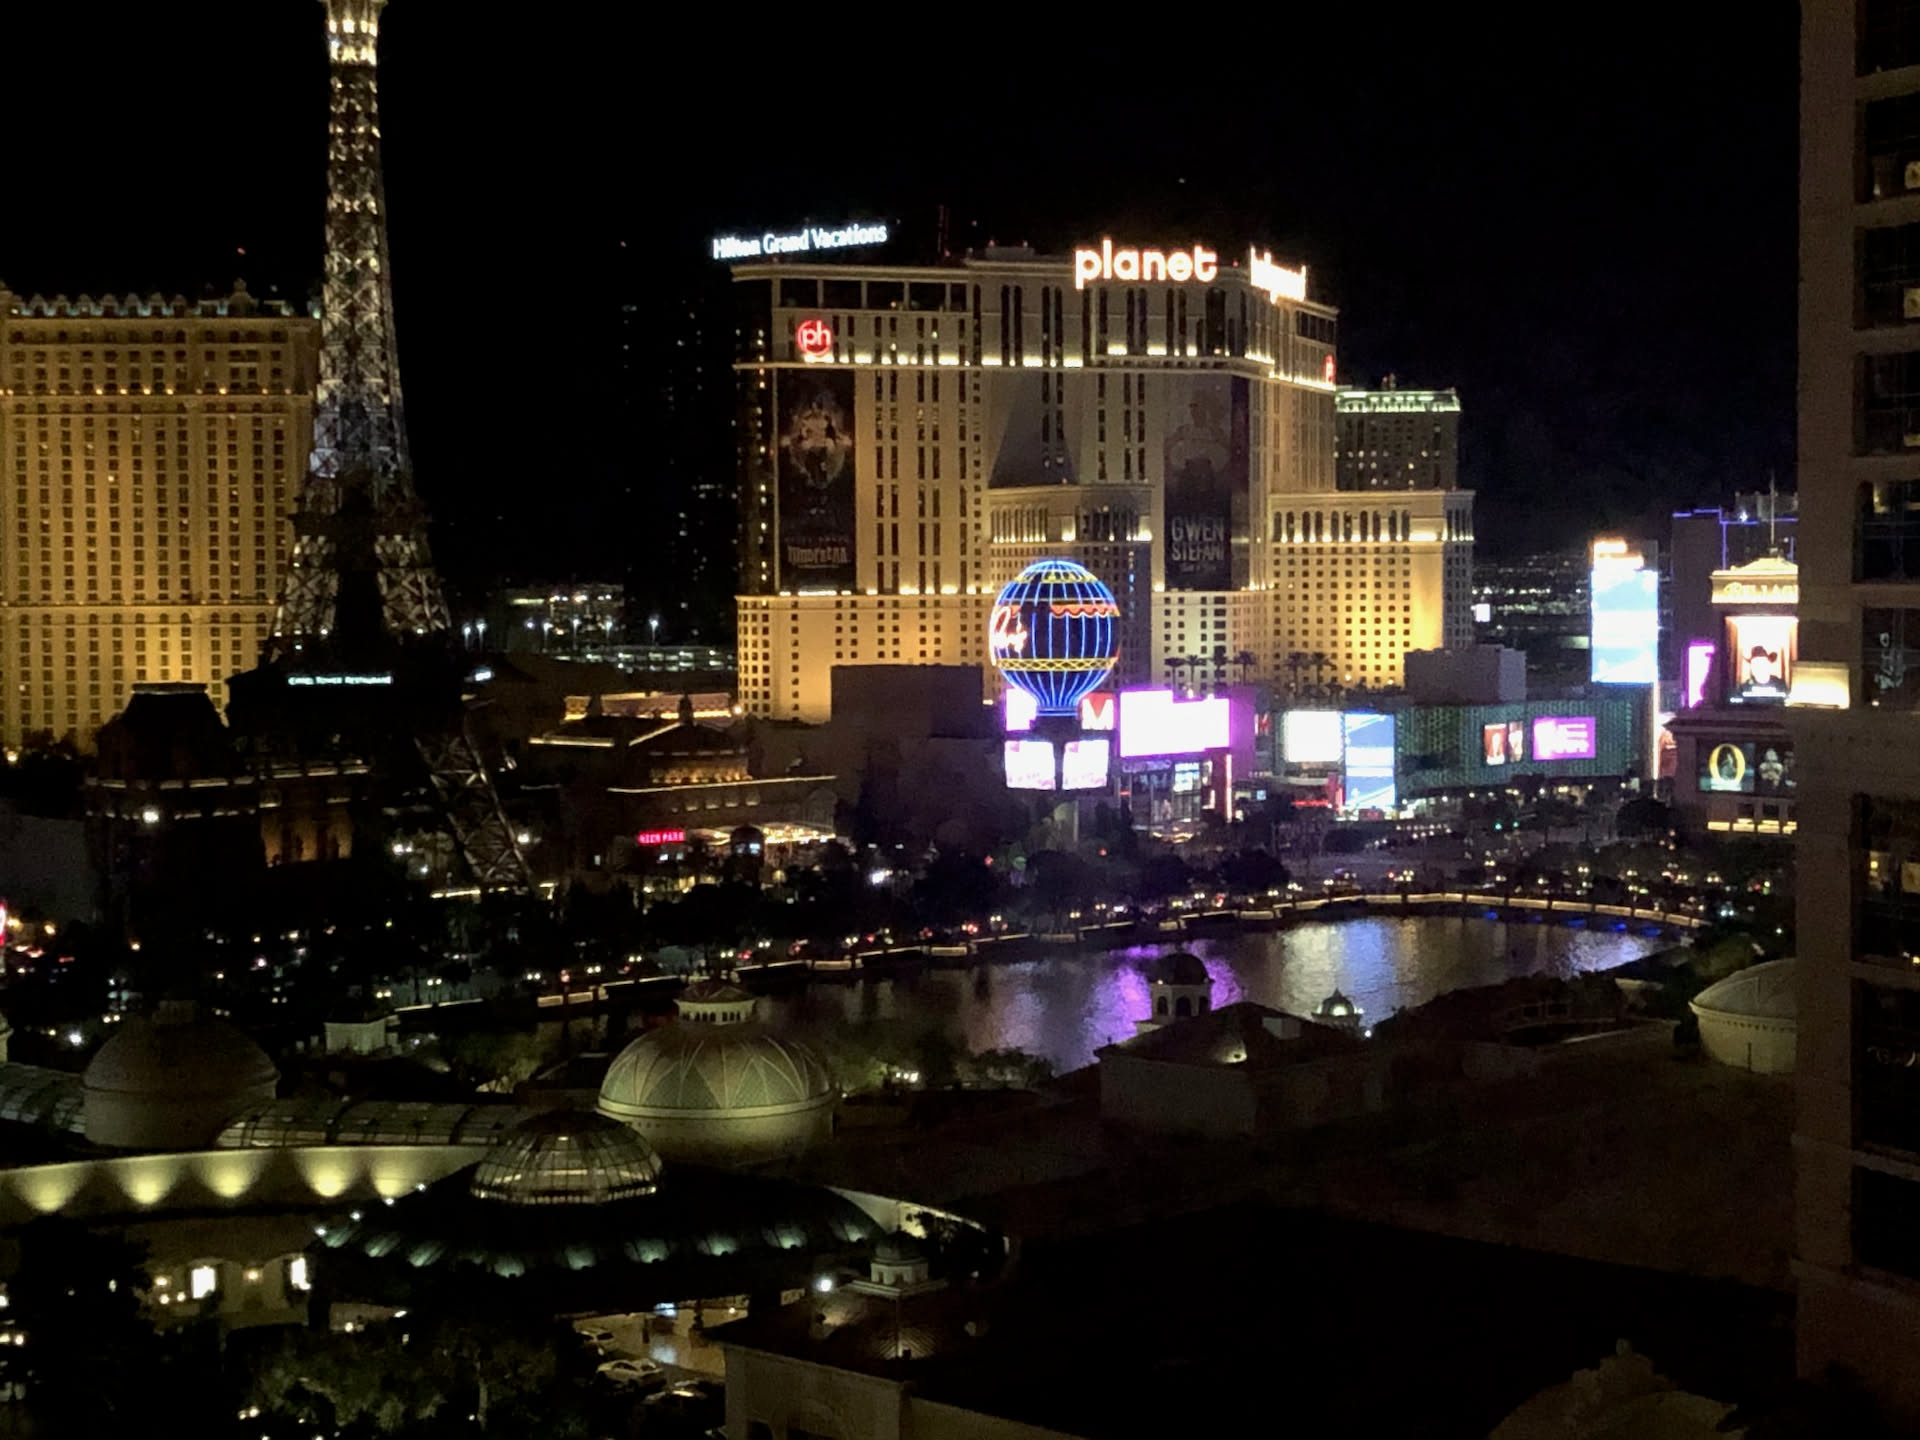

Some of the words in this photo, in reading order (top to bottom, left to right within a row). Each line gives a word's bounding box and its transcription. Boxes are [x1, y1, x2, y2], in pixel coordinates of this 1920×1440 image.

[713, 236, 761, 260] Hilton
[763, 229, 809, 254] Grand
[811, 223, 888, 249] Vacations
[1075, 237, 1218, 290] planet
[802, 319, 831, 350] ph
[1171, 515, 1225, 542] GWEN
[1171, 541, 1225, 561] STEFANI
